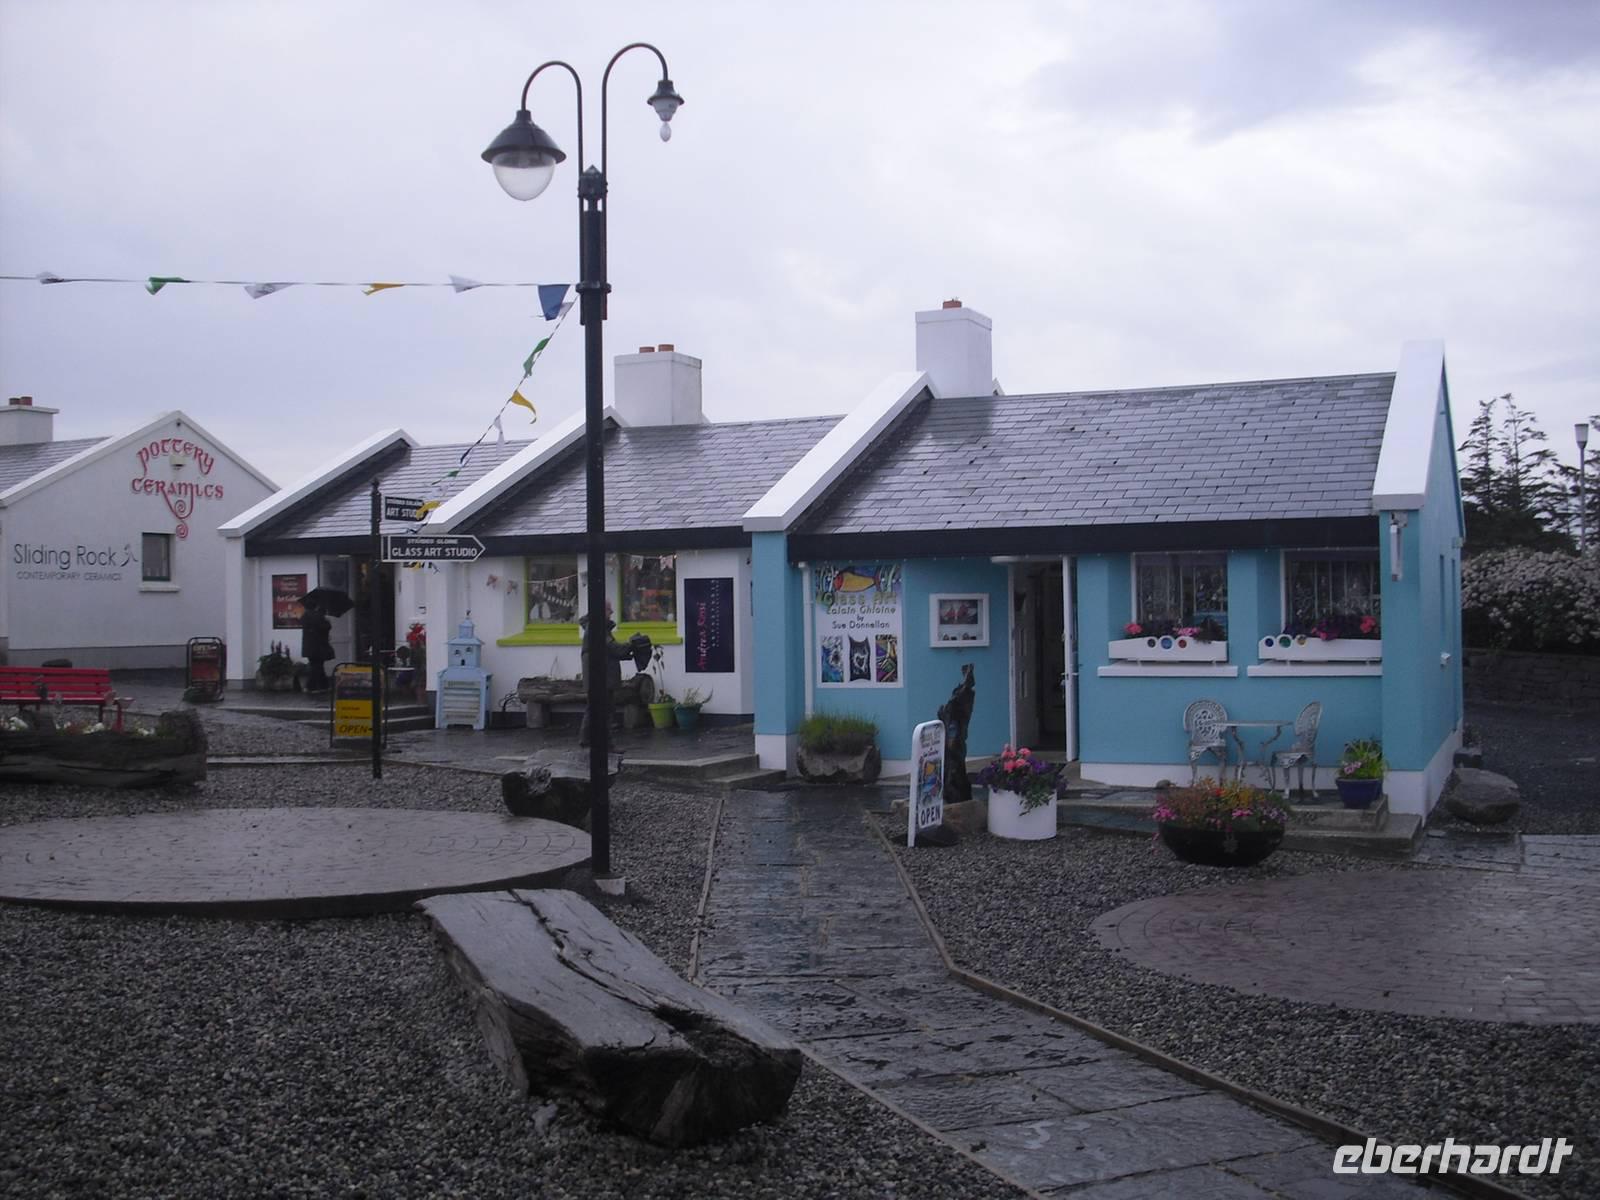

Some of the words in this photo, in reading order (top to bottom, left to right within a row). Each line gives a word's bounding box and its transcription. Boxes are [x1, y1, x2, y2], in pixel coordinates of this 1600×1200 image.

[386, 507, 400, 517] ART
[14, 543, 71, 570] Sliding
[76, 545, 117, 566] Rock
[391, 547, 422, 557] GLASS
[423, 547, 442, 557] ART
[444, 547, 478, 557] STUDIO
[16, 571, 81, 580] CONTEMPORARY
[83, 571, 123, 581] CERAMICS
[832, 620, 847, 629] Sue
[849, 620, 890, 629] Donnellan
[339, 724, 369, 735] OPEN
[920, 807, 941, 826] OPEN
